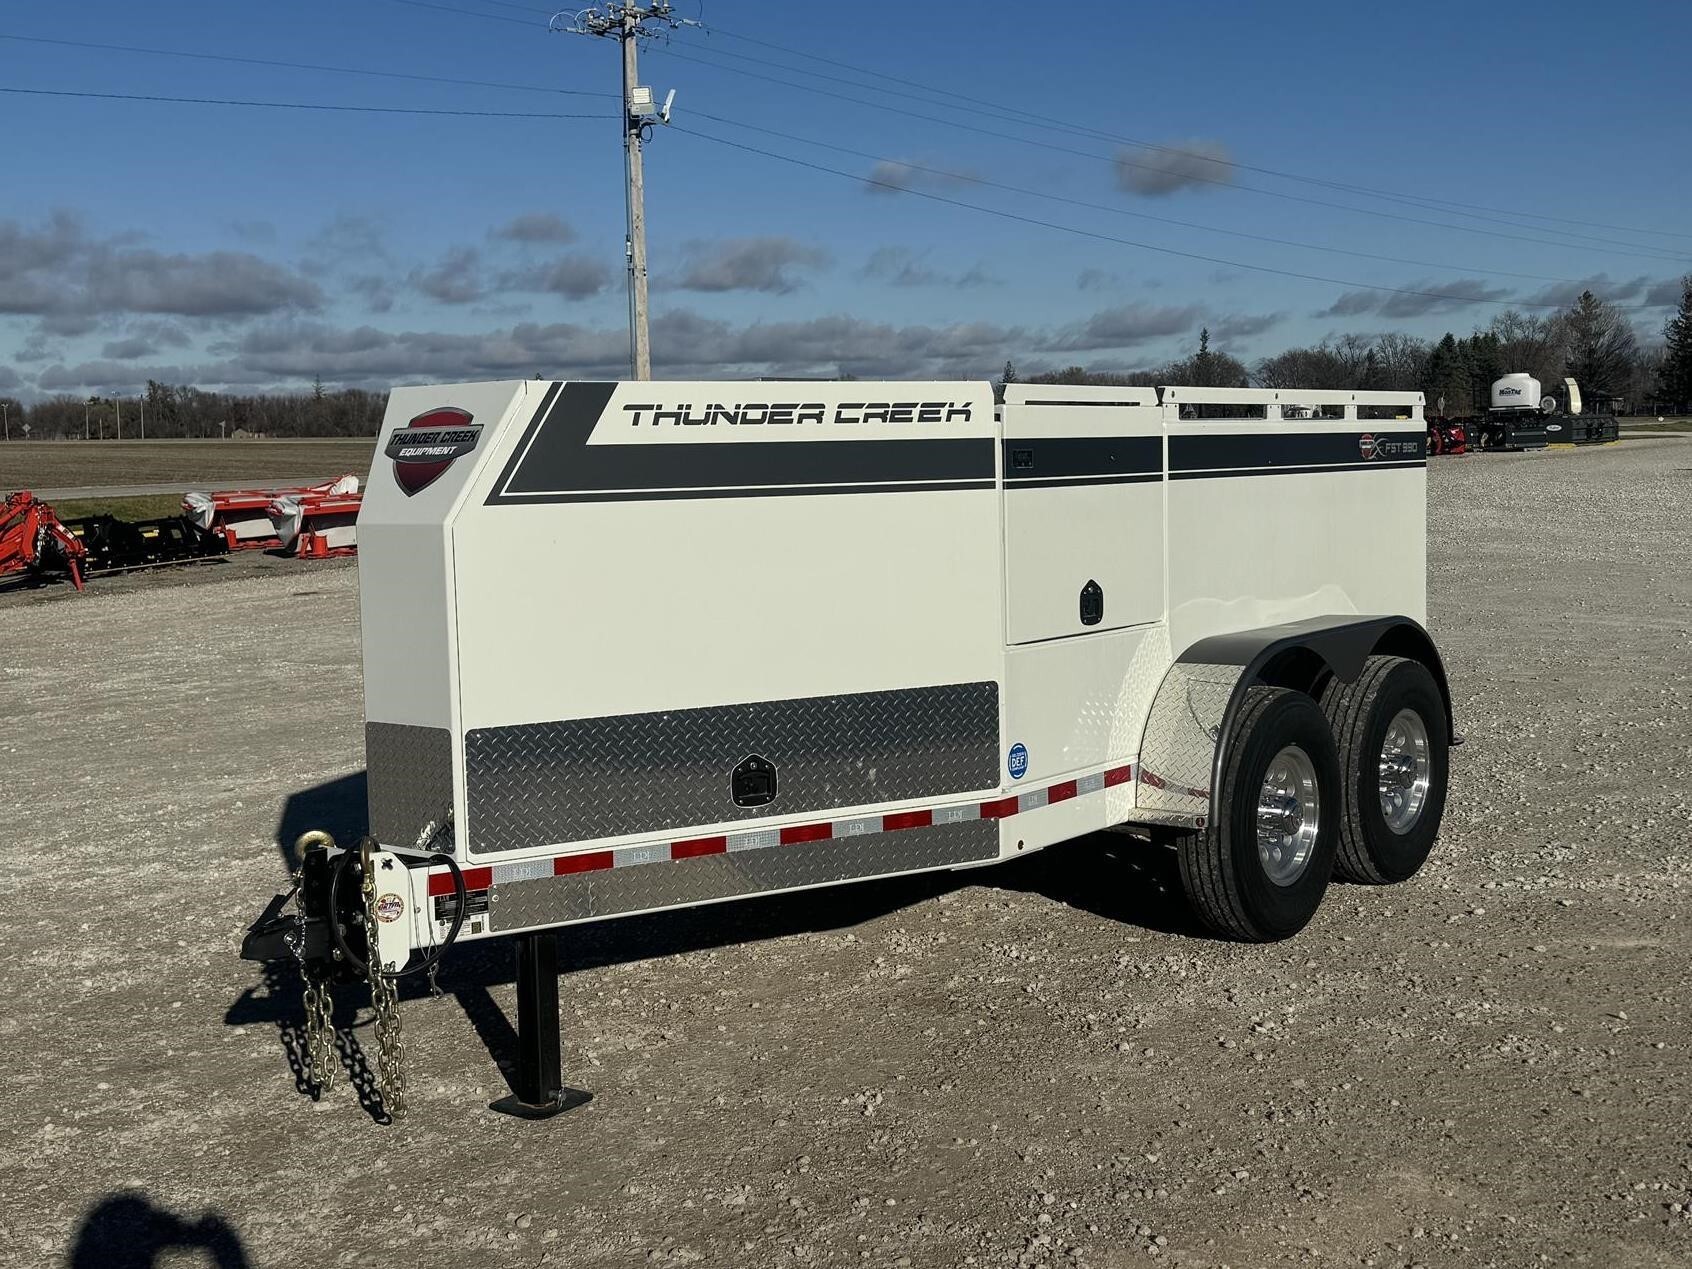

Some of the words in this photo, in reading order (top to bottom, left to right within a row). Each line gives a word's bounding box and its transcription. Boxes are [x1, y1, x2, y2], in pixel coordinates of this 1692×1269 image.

[622, 403, 826, 427] THUNDER
[833, 401, 974, 424] CREEK
[390, 431, 440, 446] THUNDER
[440, 429, 480, 443] CREEK
[398, 445, 458, 457] EQUIPMENT
[1385, 443, 1402, 453] FST
[1011, 756, 1025, 768] DEF
